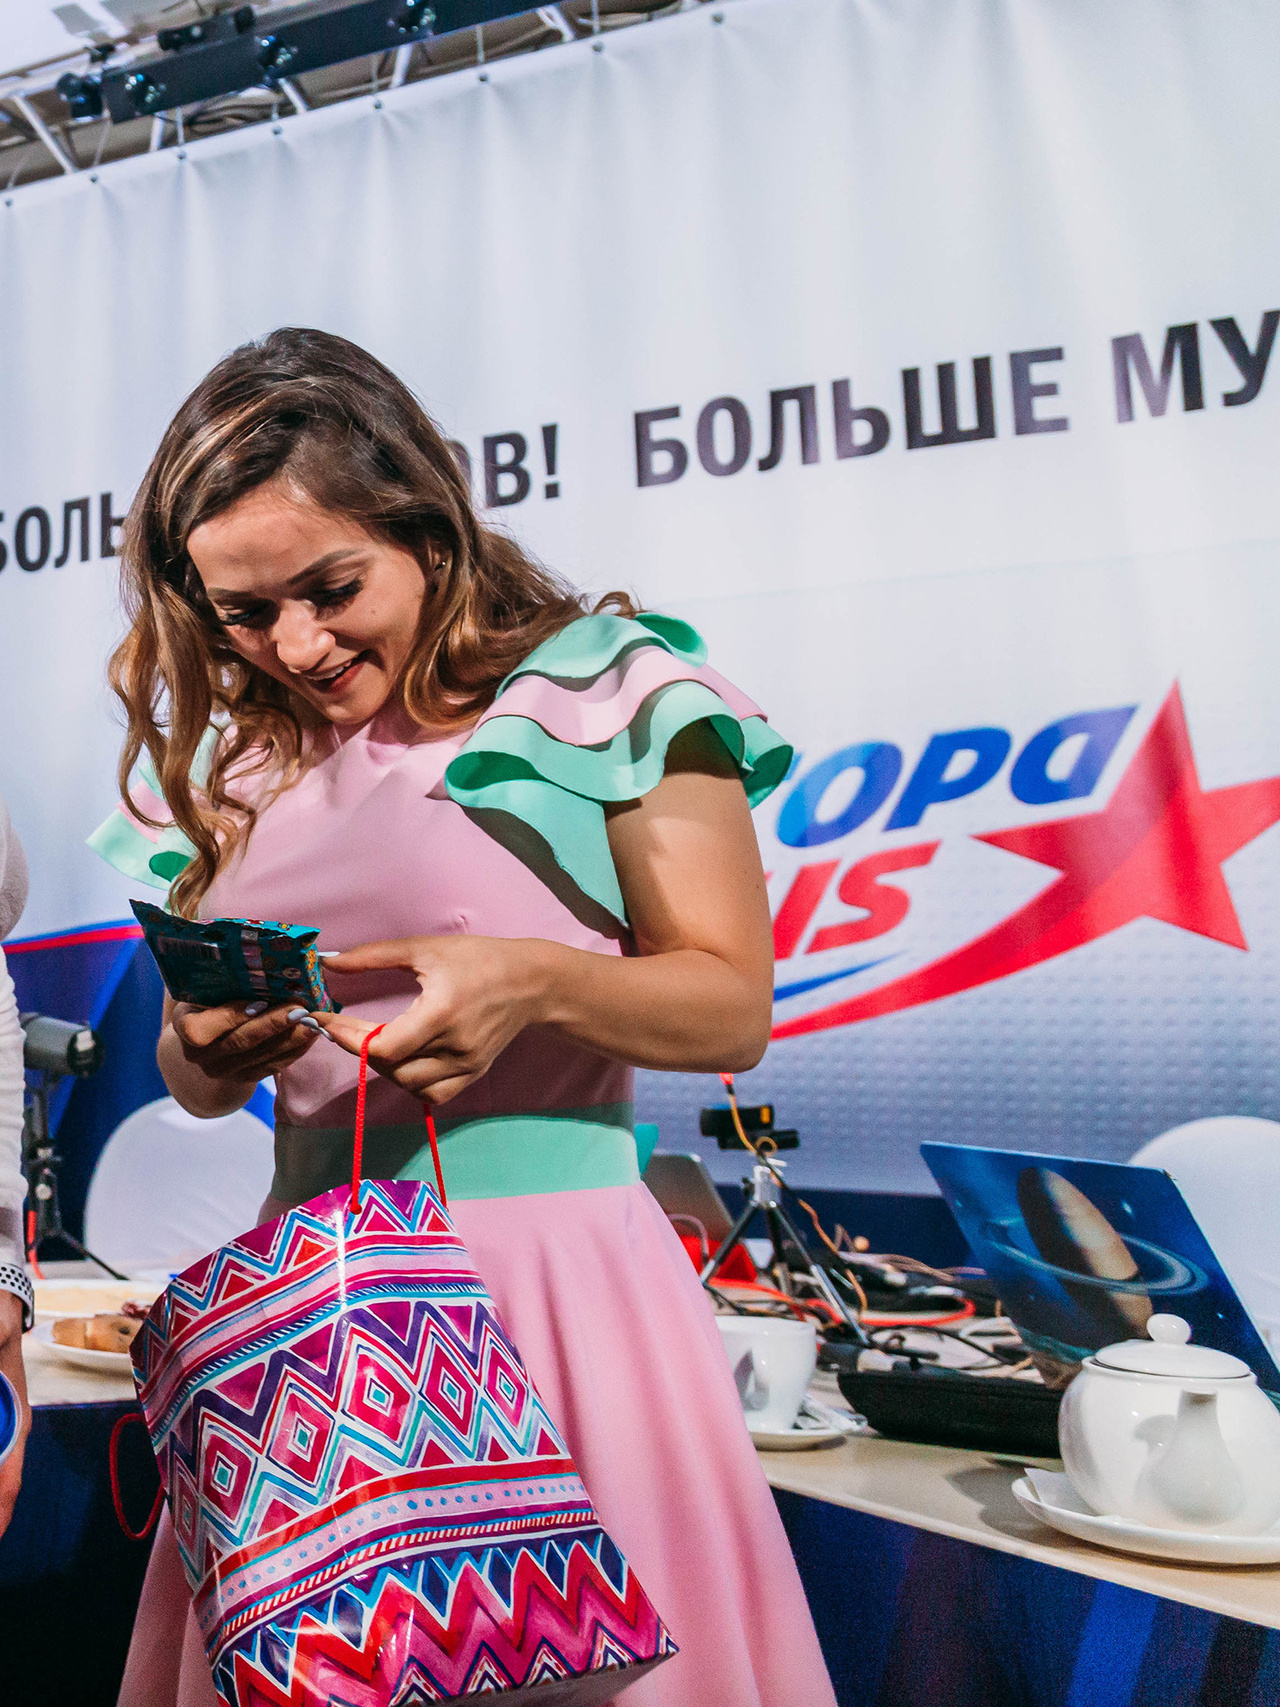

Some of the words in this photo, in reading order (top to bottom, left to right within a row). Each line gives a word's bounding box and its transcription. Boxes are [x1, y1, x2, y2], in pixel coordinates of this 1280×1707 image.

[633, 345, 1072, 488] БОЛЬШЕ
[1110, 308, 1280, 424] МУ
[777, 703, 1139, 849] opa
